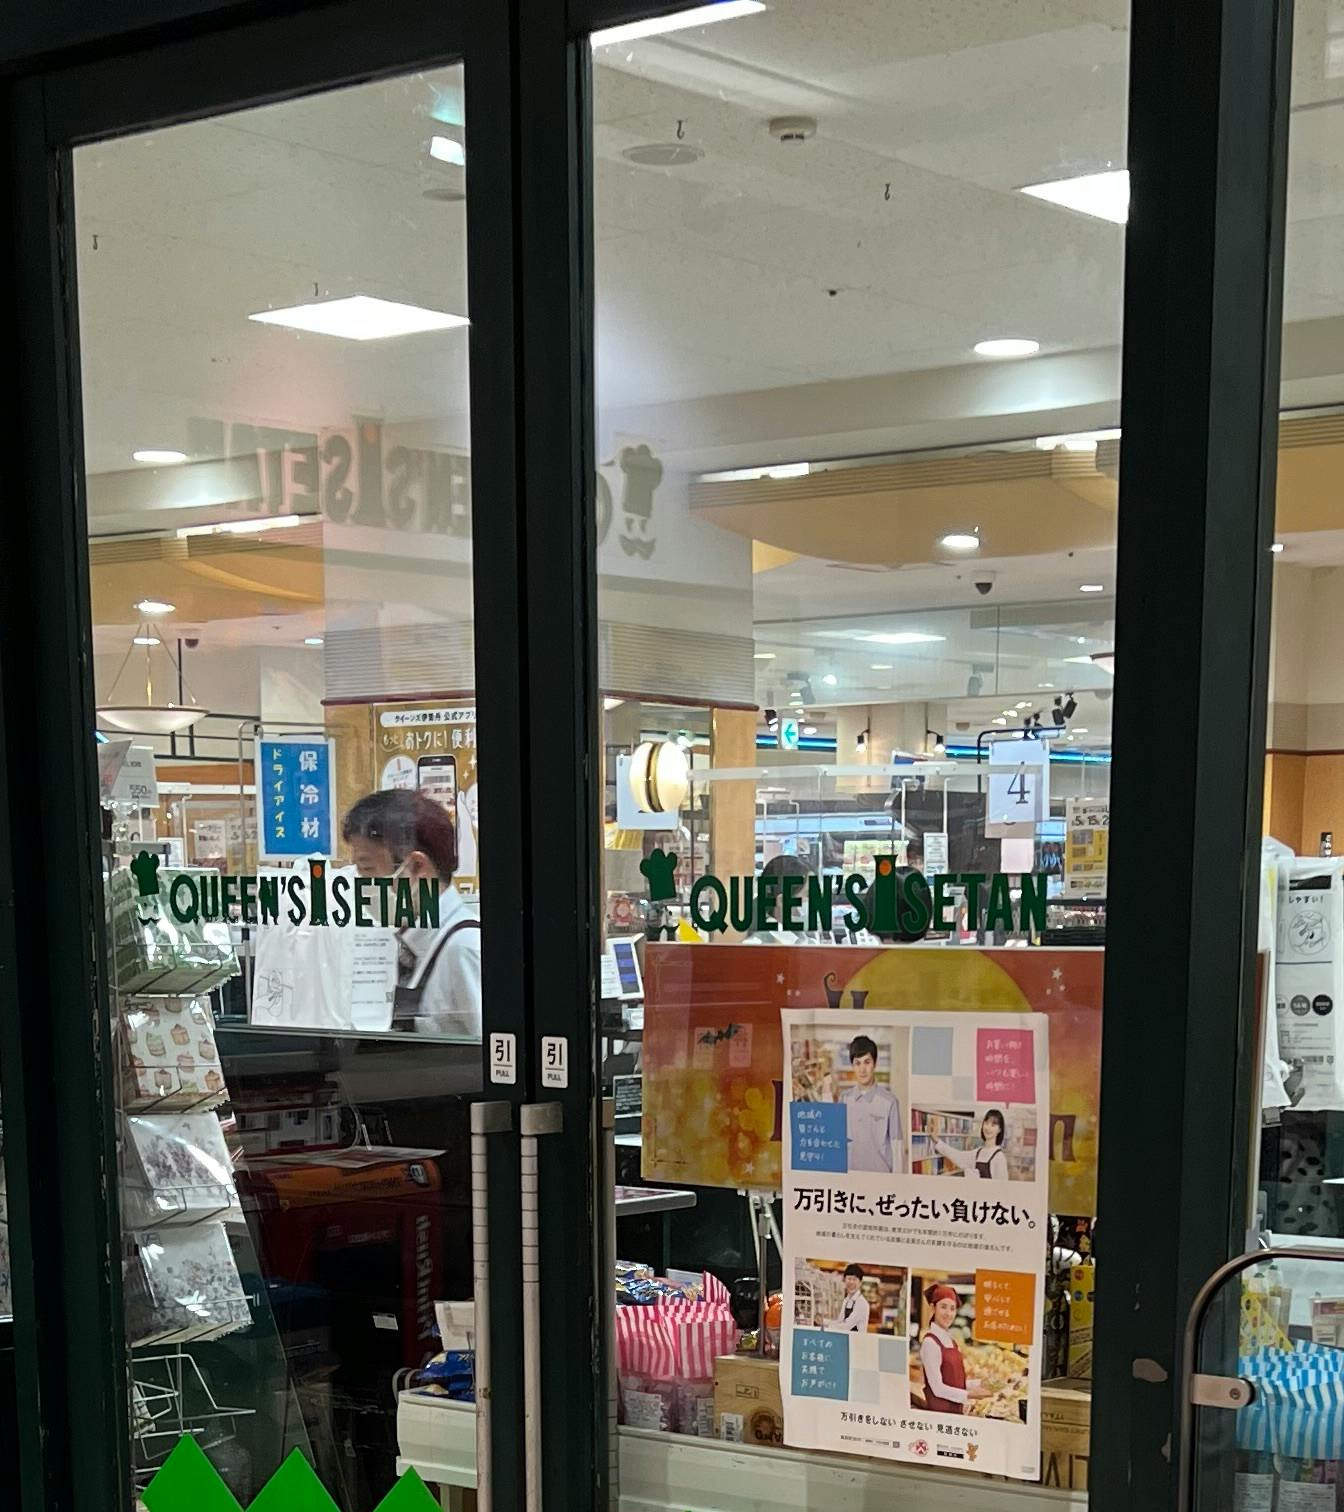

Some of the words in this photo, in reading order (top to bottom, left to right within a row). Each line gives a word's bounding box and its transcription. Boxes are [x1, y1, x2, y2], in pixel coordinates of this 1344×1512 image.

[271, 747, 286, 839] ドライアイス
[298, 750, 320, 839] 保冷材
[1007, 761, 1031, 805] 4
[169, 872, 307, 927] QUEEN'S
[690, 871, 869, 933] QUEEN'S
[870, 854, 1047, 933] ISETAN
[495, 1039, 511, 1062] 引
[547, 1043, 563, 1066] 引
[495, 1069, 510, 1078] PULL
[547, 1073, 562, 1082] PULL
[793, 1187, 1037, 1230] 万引きに、ぜったい負けない。
[840, 1411, 897, 1427] 万引きをしない
[899, 1418, 934, 1431] させない
